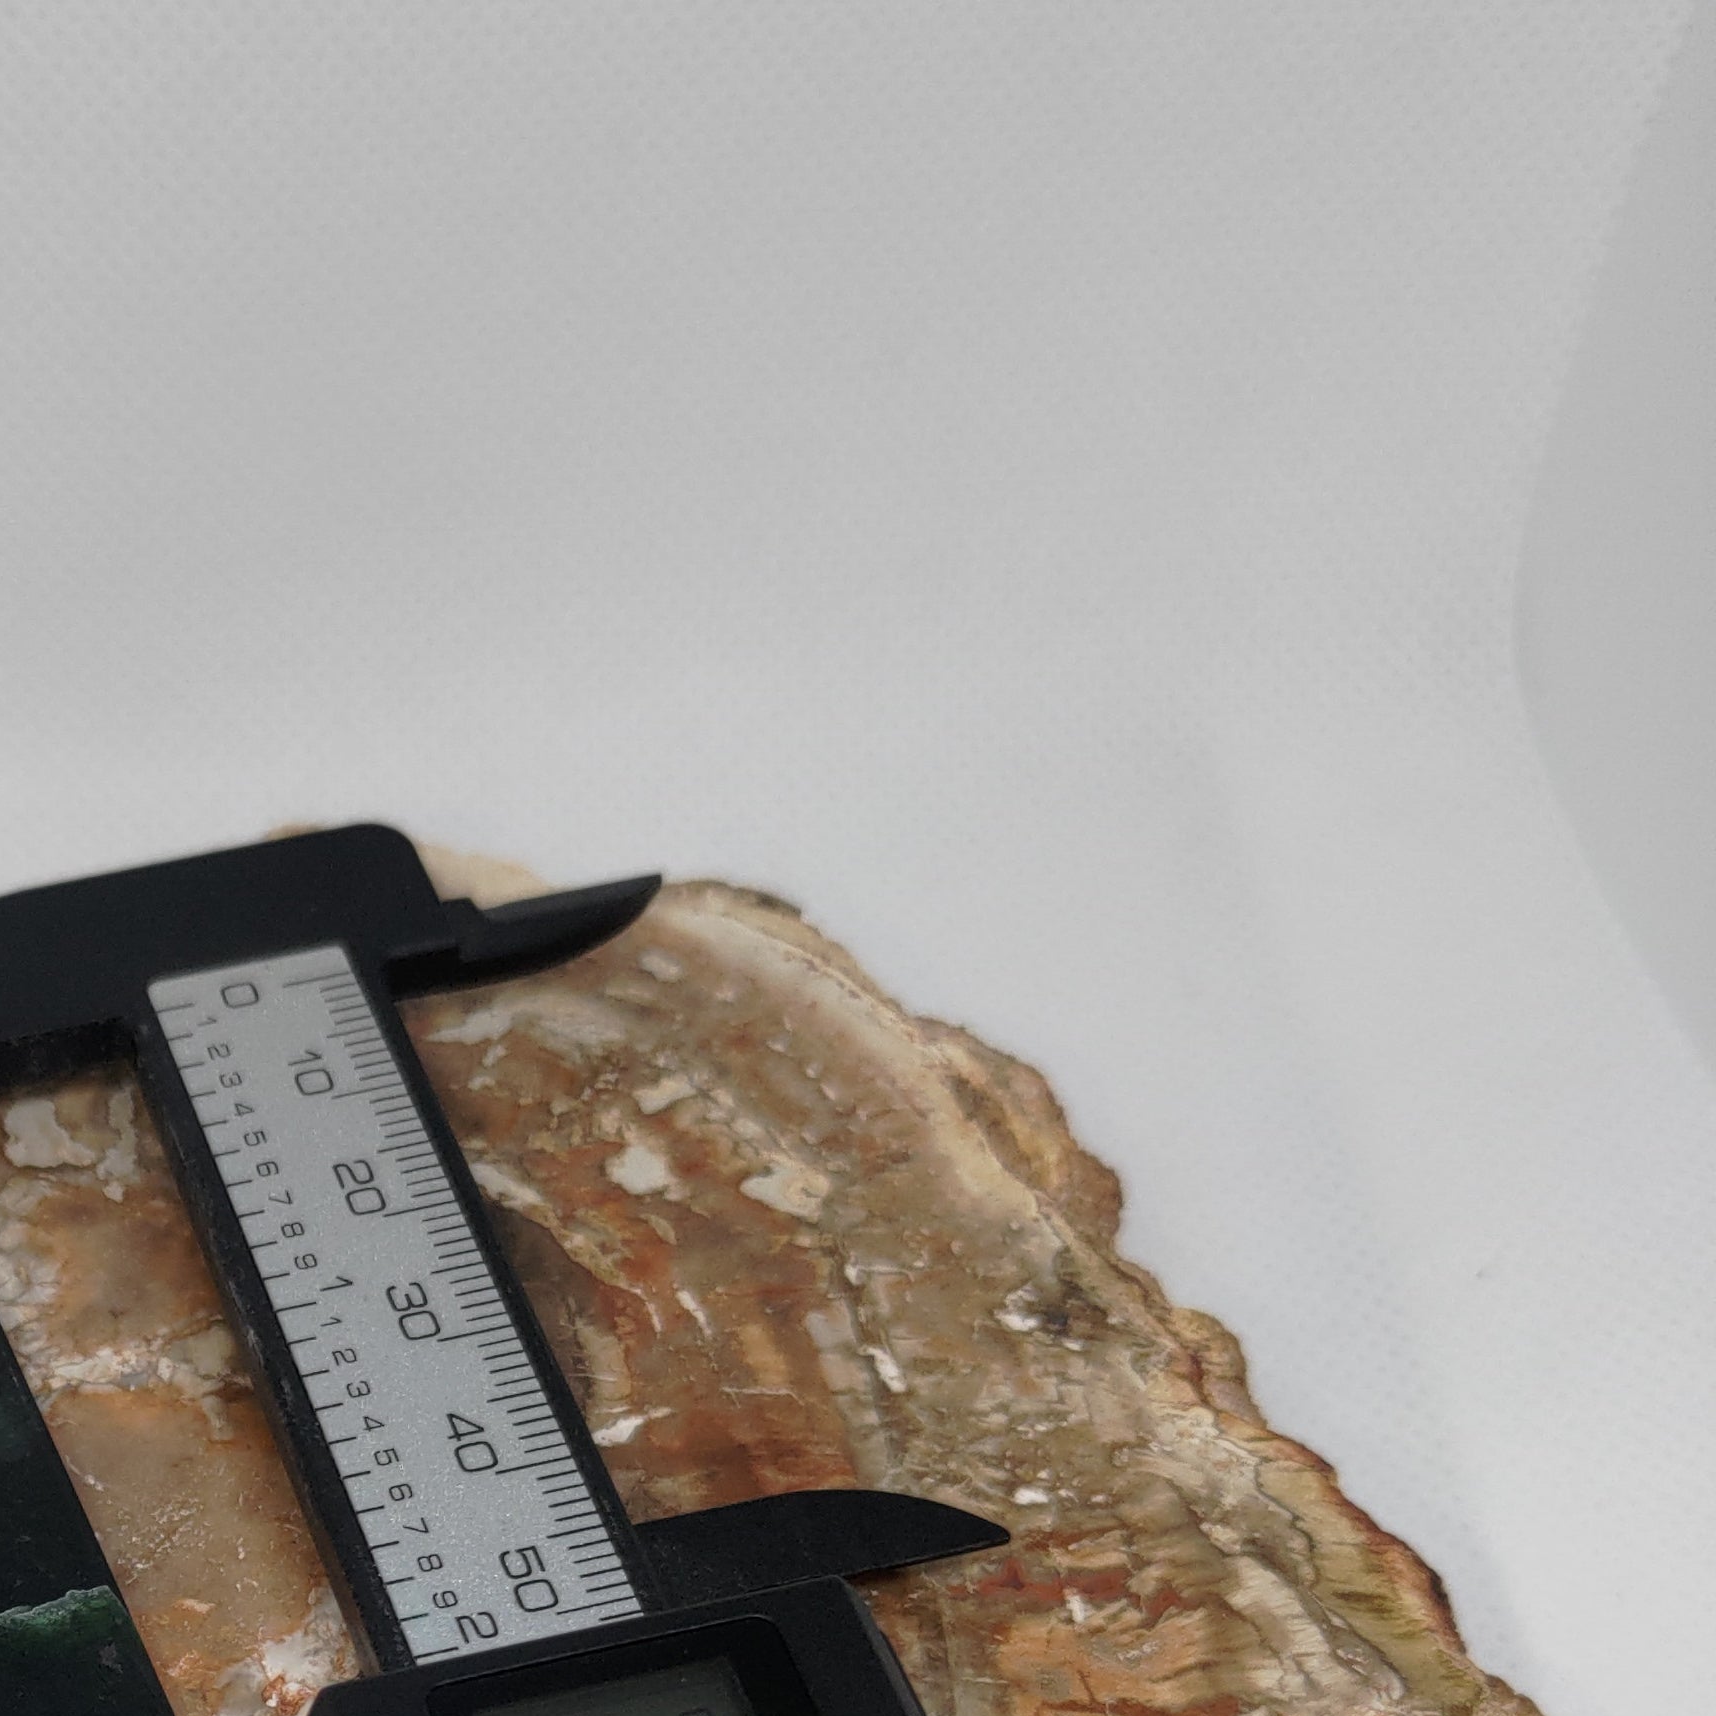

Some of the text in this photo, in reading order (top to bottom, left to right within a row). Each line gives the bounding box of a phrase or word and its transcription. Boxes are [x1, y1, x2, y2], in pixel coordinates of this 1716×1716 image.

[220, 982, 259, 1009] 0
[196, 1015, 217, 1027] 1
[207, 1043, 231, 1060] 2
[219, 1072, 242, 1088] 3
[288, 1049, 334, 1096] 10
[233, 1102, 255, 1117] 4
[243, 1130, 268, 1147] 5
[256, 1160, 279, 1177] 6
[333, 1160, 386, 1216] 20
[268, 1190, 294, 1206] 7
[281, 1222, 305, 1238] 8
[294, 1253, 318, 1270] 9
[320, 1275, 353, 1292] 1
[386, 1282, 441, 1341] 30
[320, 1316, 342, 1328] 1
[331, 1347, 357, 1366] 2
[346, 1380, 370, 1398] 3
[363, 1415, 385, 1432] 4
[446, 1412, 498, 1473] 40
[374, 1447, 399, 1466] 5
[388, 1483, 413, 1501] 6
[403, 1517, 429, 1535] 7
[418, 1553, 443, 1572] 8
[498, 1545, 559, 1613] 50
[432, 1590, 458, 1609] 9
[455, 1611, 498, 1644] 2
